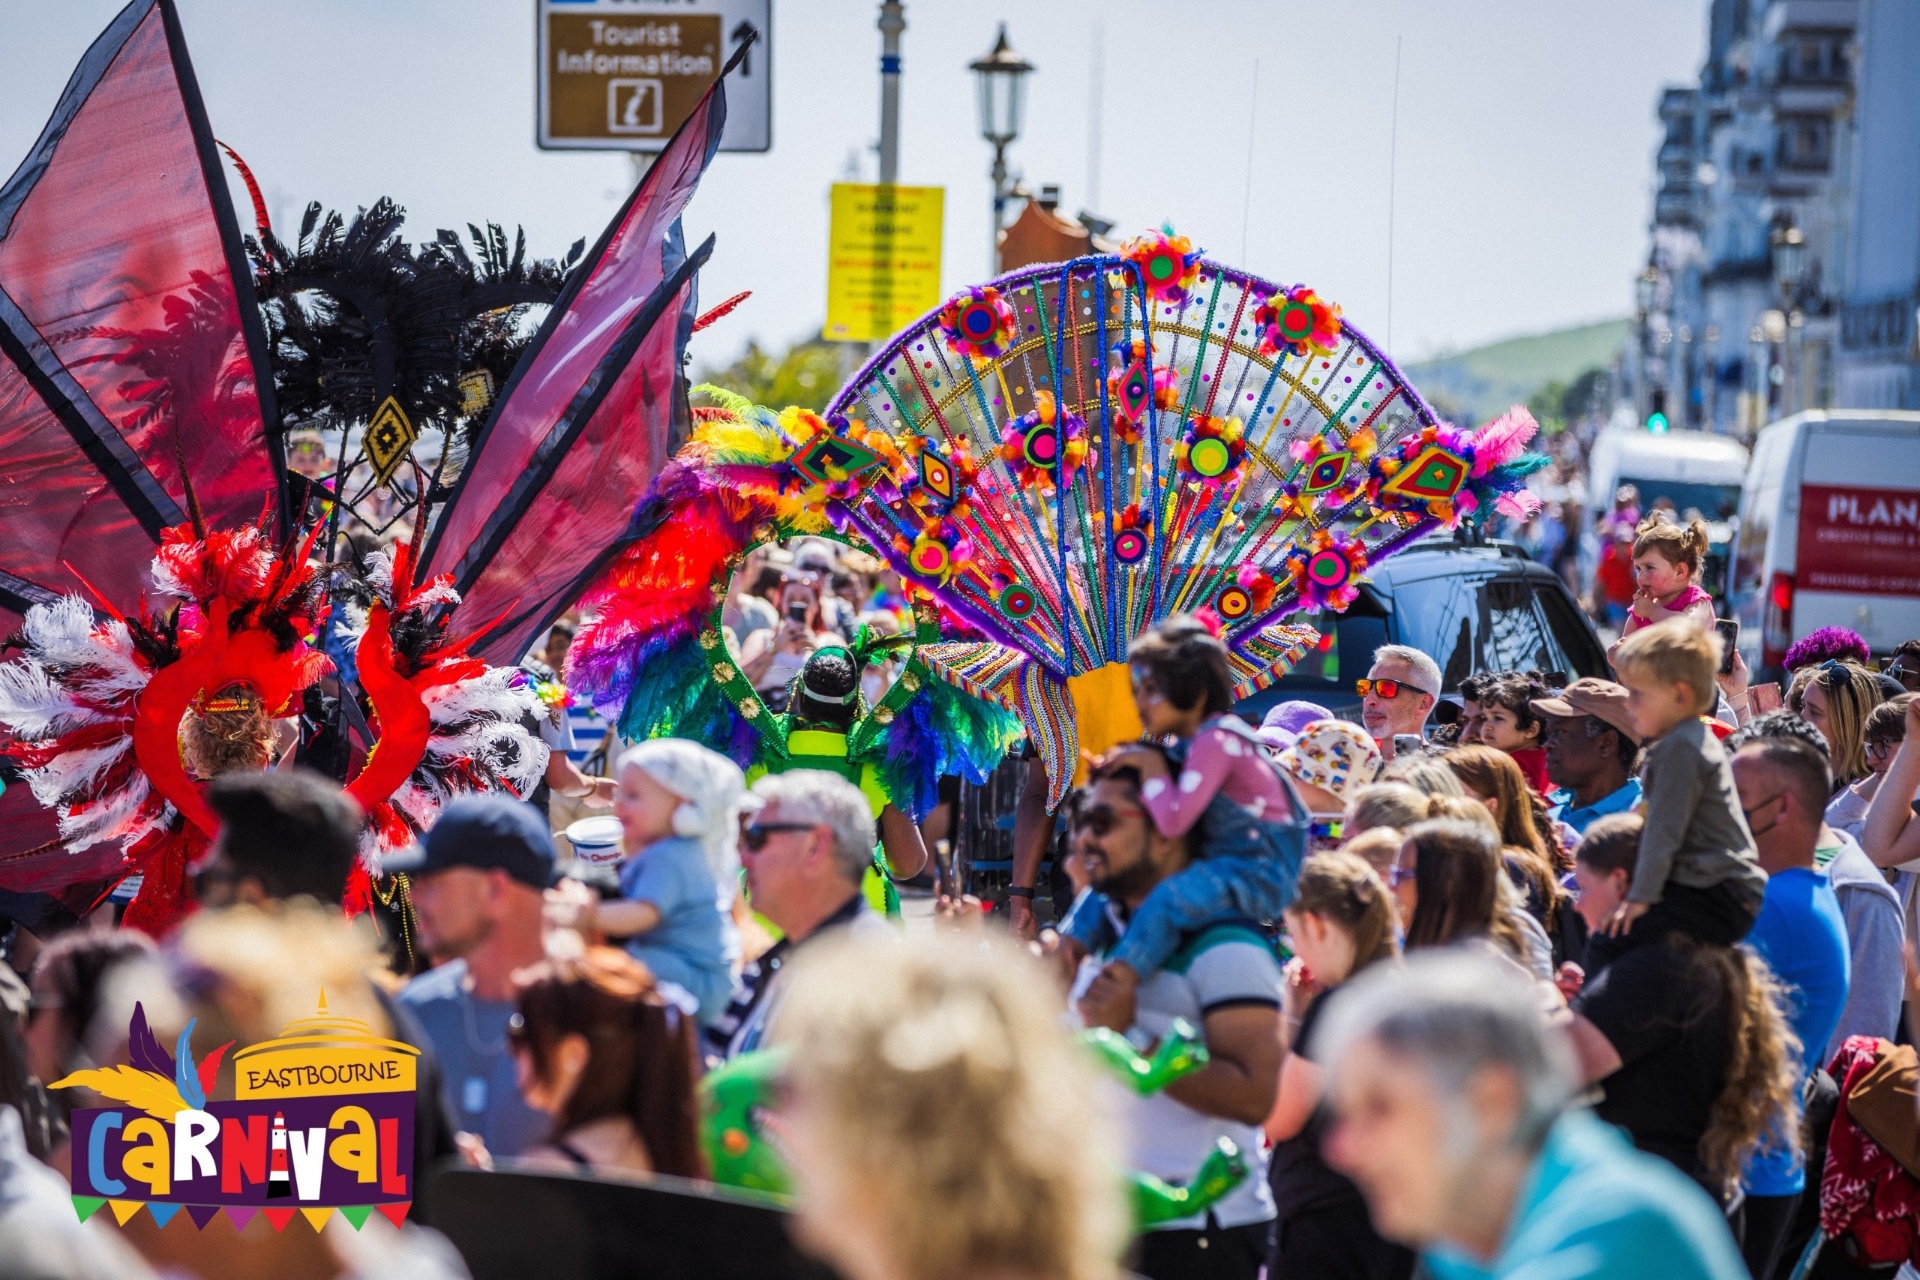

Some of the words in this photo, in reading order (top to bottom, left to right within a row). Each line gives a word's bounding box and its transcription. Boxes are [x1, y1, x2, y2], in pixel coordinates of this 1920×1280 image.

[590, 20, 682, 46] Tourist
[557, 50, 714, 74] Information
[1828, 495, 1920, 526] PLAN
